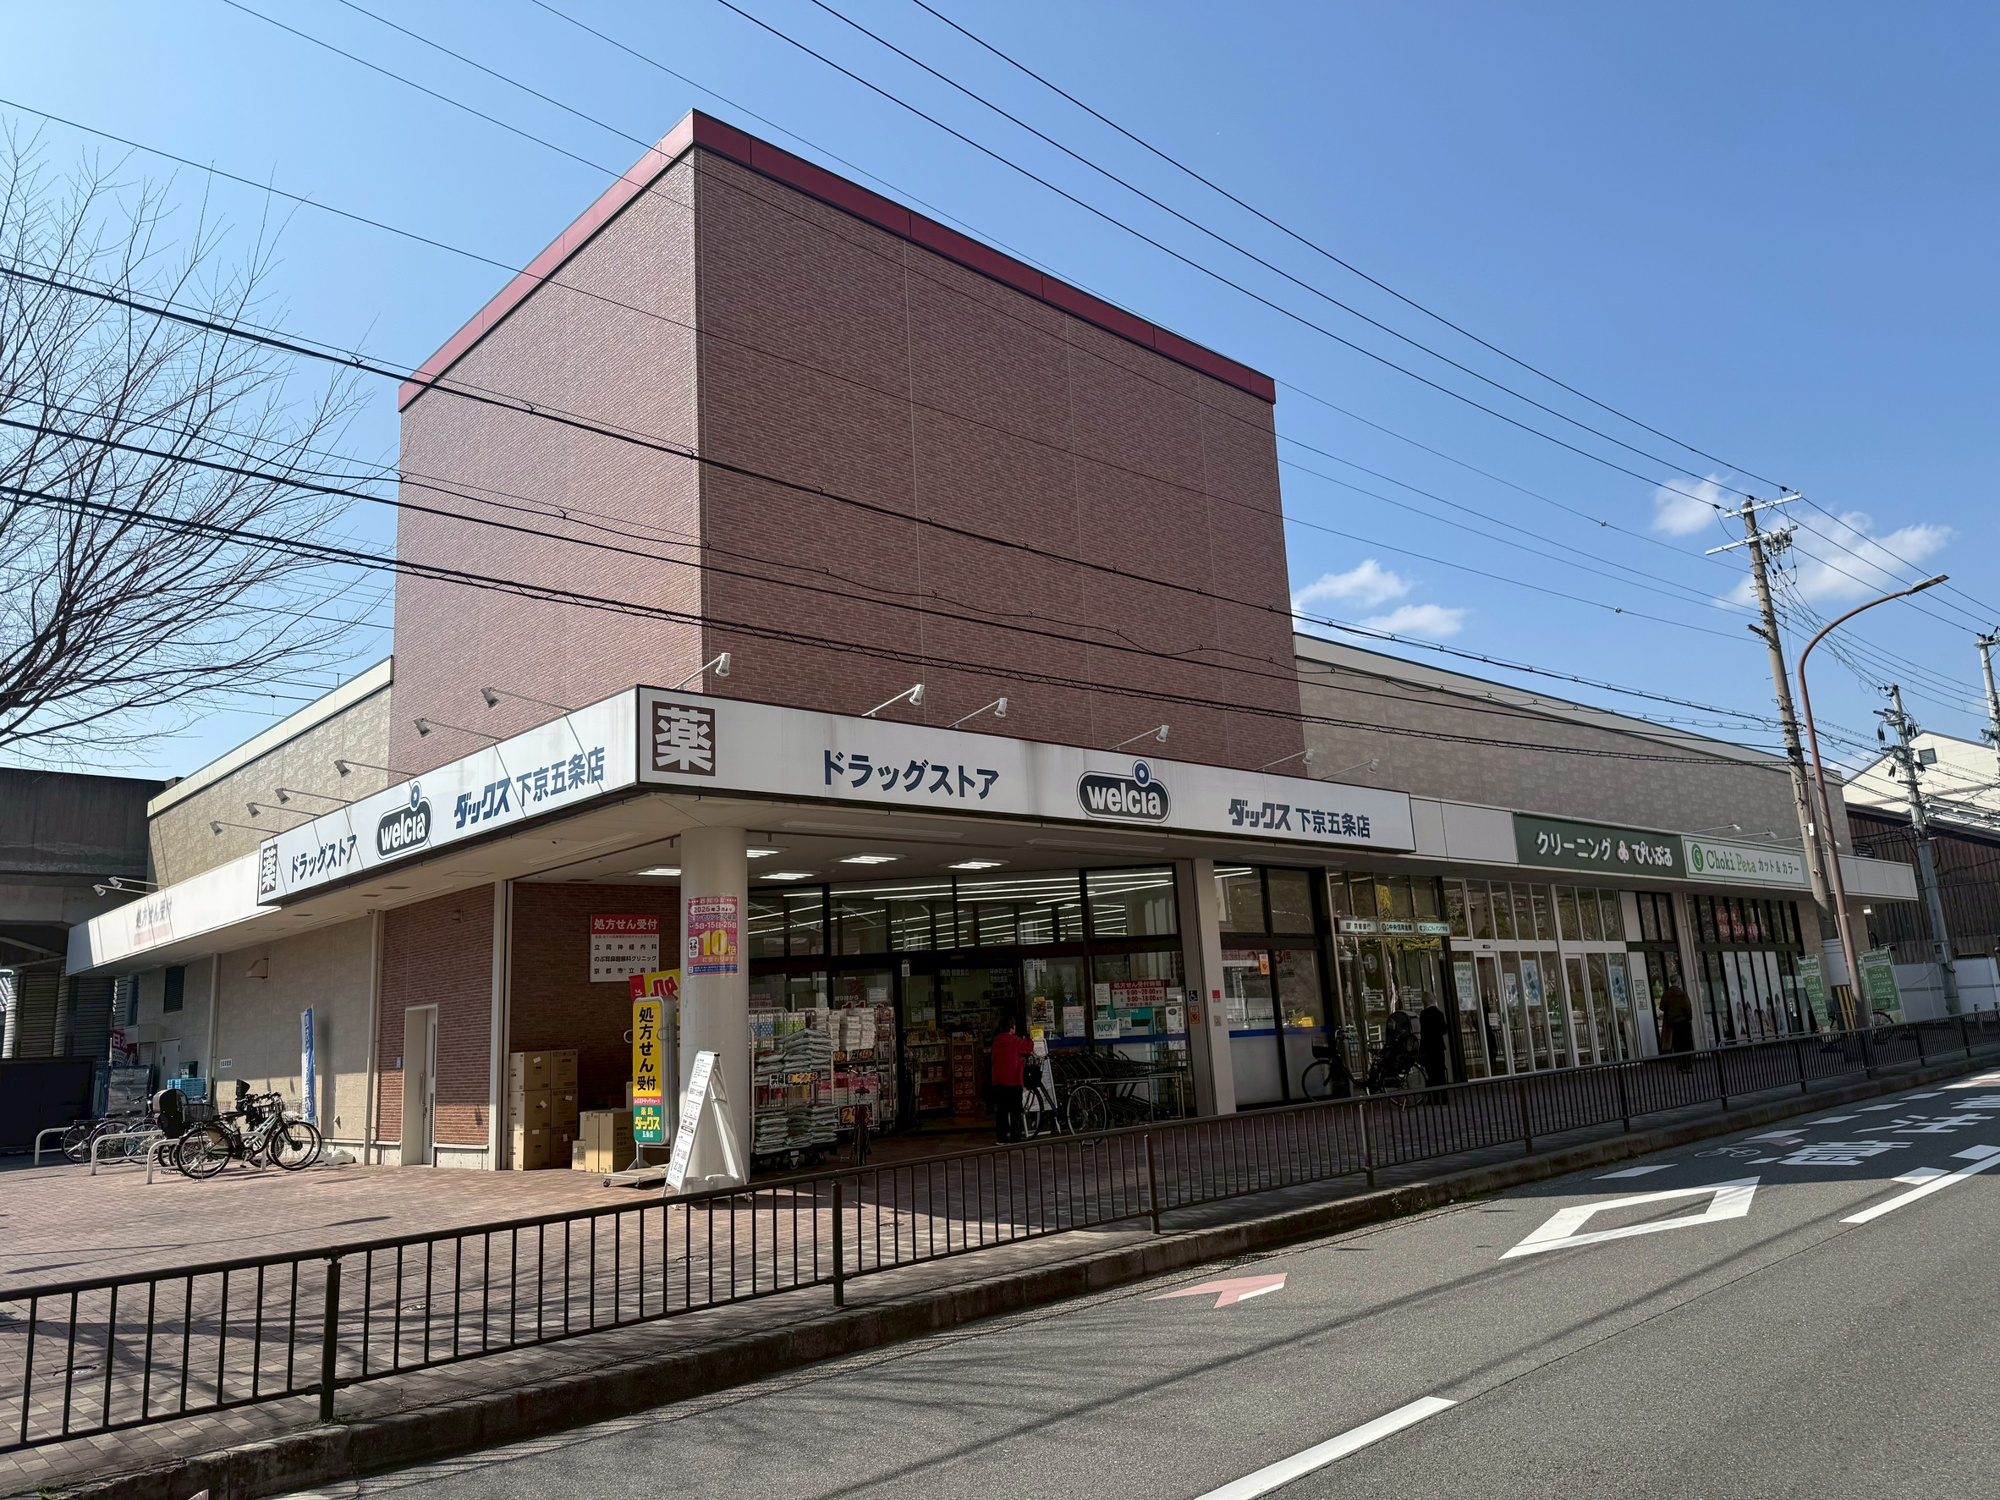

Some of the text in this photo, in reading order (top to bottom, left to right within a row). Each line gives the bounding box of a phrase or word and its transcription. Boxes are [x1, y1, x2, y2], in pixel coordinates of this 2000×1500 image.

[655, 706, 713, 772] 薬
[454, 746, 605, 830] ダックス 下京五条店
[824, 749, 999, 800] ドラッグストア
[1086, 762, 1161, 816] welcia
[380, 785, 427, 851] welcia
[1228, 798, 1371, 839] ダックス 下京五条店
[291, 834, 357, 883] ドラッグストア
[1536, 831, 1611, 861] クリーニング
[1707, 849, 1735, 871] Choki
[1736, 852, 1757, 873] Peta
[261, 846, 278, 894] 薬
[594, 919, 658, 930] 処方せん受付
[594, 967, 657, 975] 京都市立病院
[1113, 980, 1162, 989] 処方せん受付時間
[1096, 1023, 1117, 1033] NOV
[635, 1116, 661, 1131] ダックス
